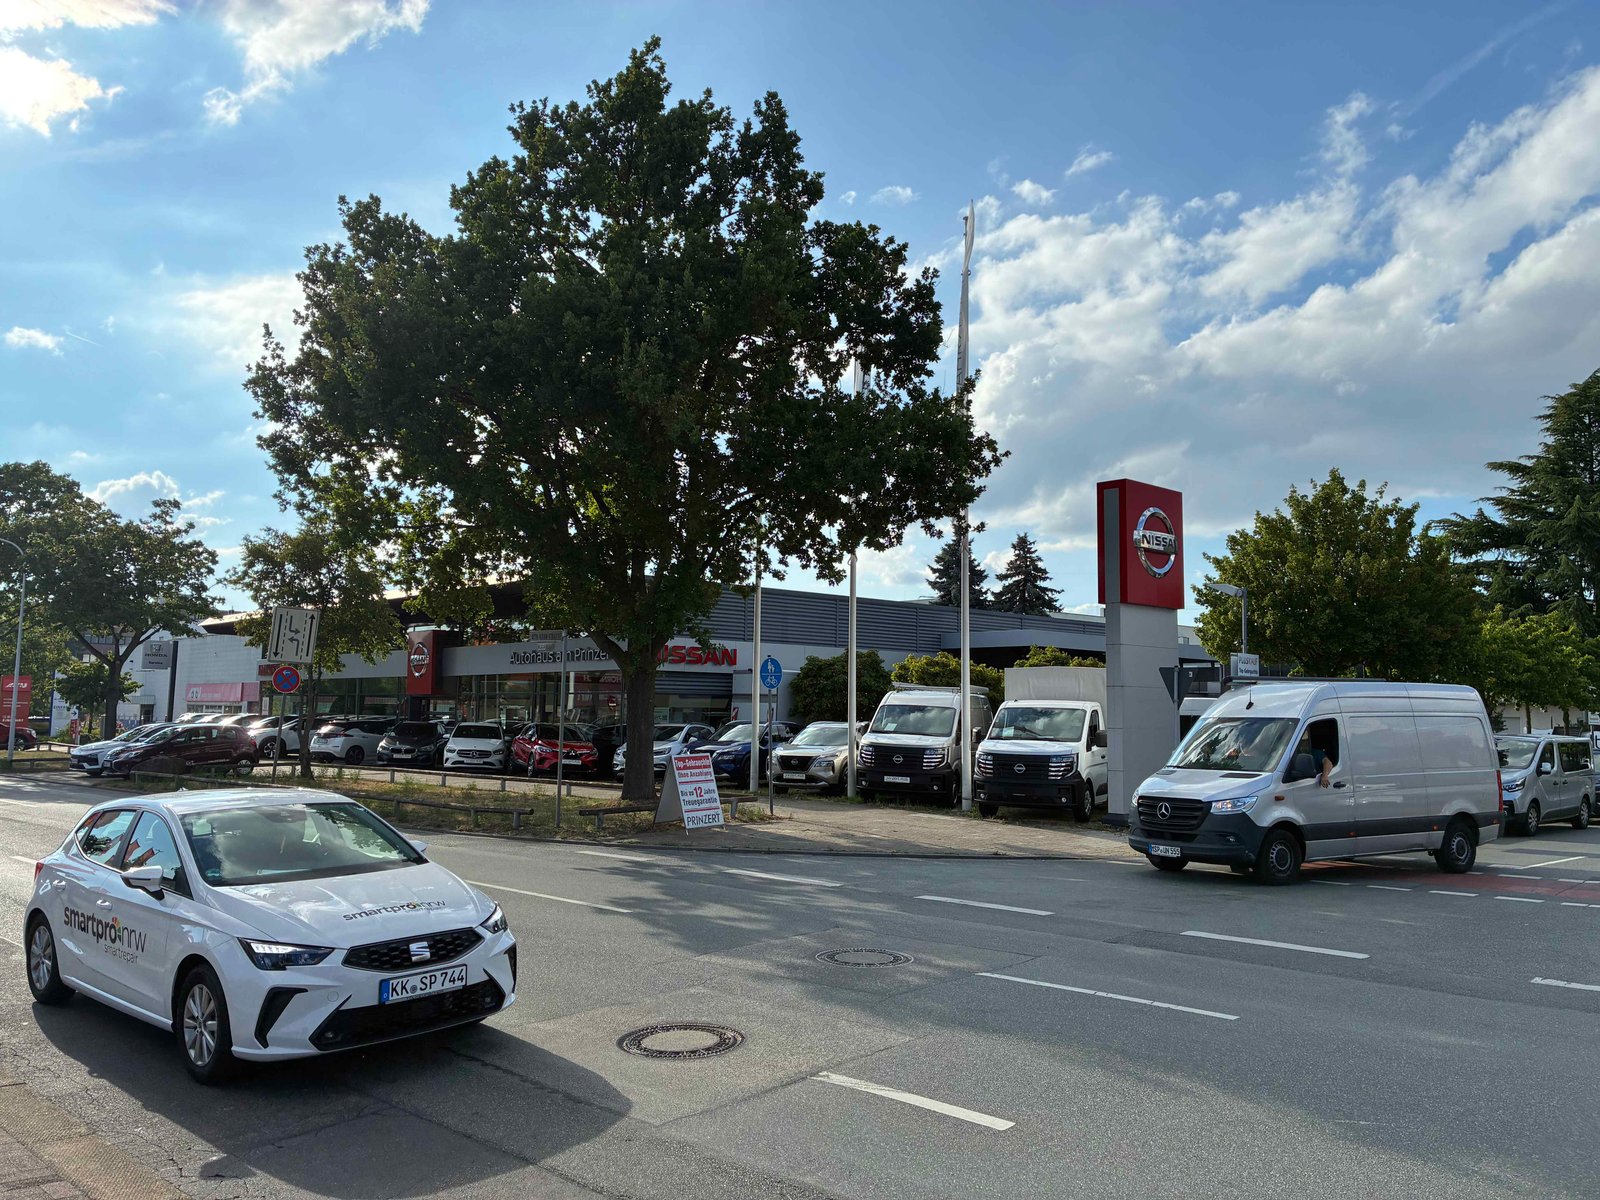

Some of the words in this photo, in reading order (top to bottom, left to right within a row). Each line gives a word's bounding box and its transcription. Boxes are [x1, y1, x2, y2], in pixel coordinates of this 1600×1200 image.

[510, 649, 554, 665] Autohaus
[690, 770, 712, 779] Anzahlung
[694, 786, 704, 798] 12
[683, 797, 718, 807] Treuegarantie
[391, 979, 409, 998] KK
[420, 974, 437, 991] SP
[441, 968, 465, 987] 744
